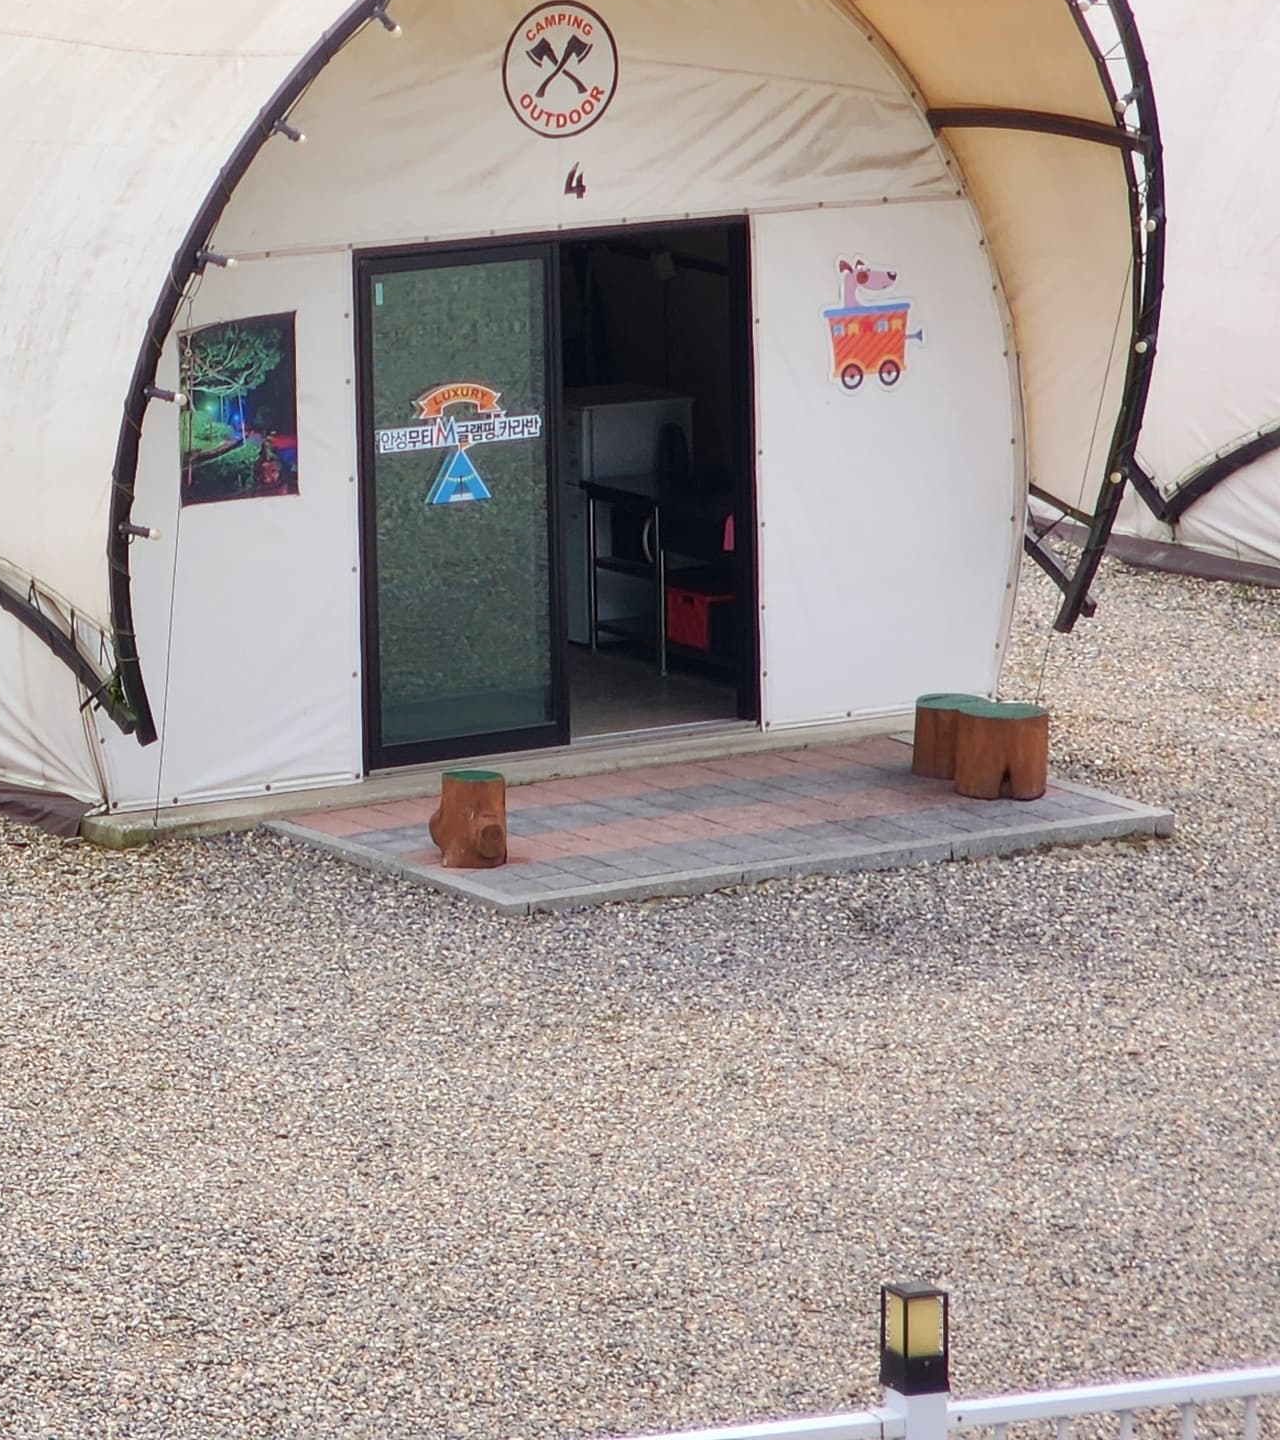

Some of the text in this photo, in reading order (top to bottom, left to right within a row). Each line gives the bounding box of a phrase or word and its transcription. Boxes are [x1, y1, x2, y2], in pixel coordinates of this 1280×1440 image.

[526, 13, 593, 41] CAMPING
[520, 85, 605, 128] OUTDOOR
[564, 161, 586, 199] 4
[433, 388, 487, 406] LUXURY
